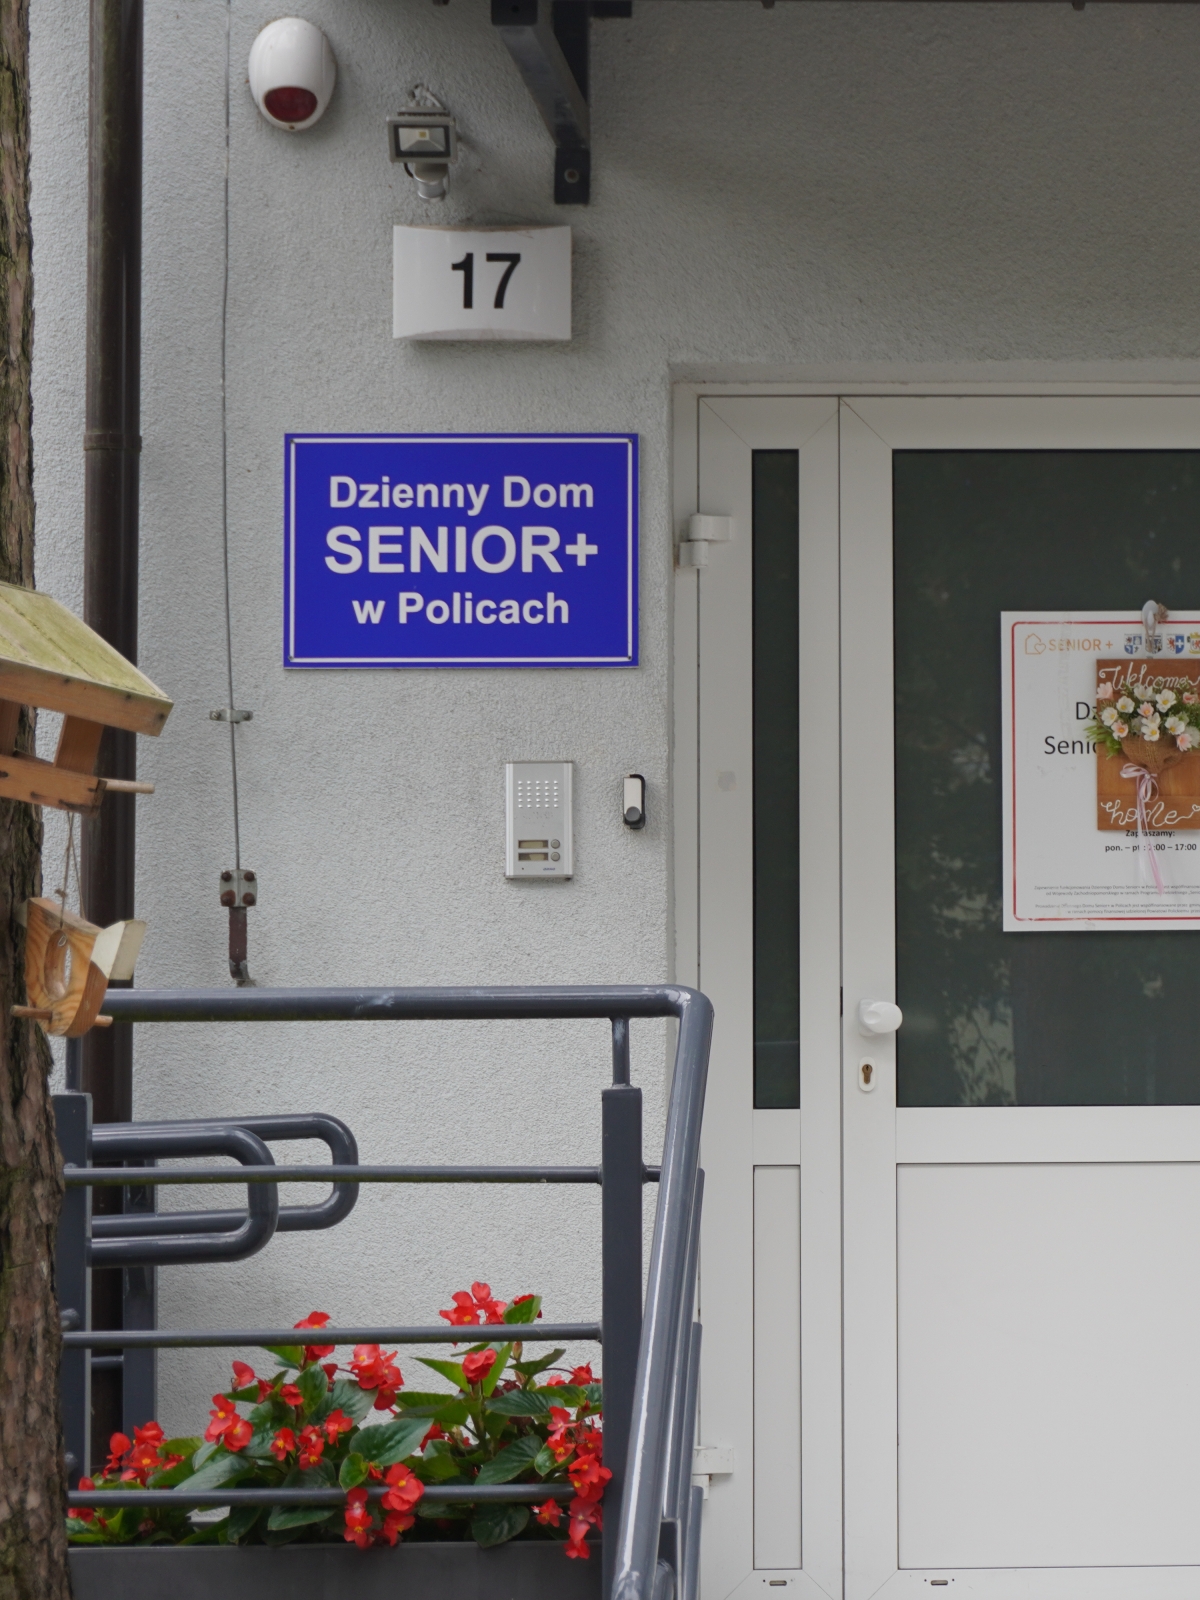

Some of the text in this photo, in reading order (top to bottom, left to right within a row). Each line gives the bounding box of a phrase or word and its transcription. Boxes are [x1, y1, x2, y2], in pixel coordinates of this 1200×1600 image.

[451, 252, 522, 309] 17
[329, 476, 594, 516] Dzienny Dom
[324, 525, 598, 574] SENIOR+
[351, 592, 569, 625] w Policach
[1048, 638, 1102, 652] SENIOR
[1104, 845, 1123, 853] pon.
[1175, 843, 1197, 851] 17:00
